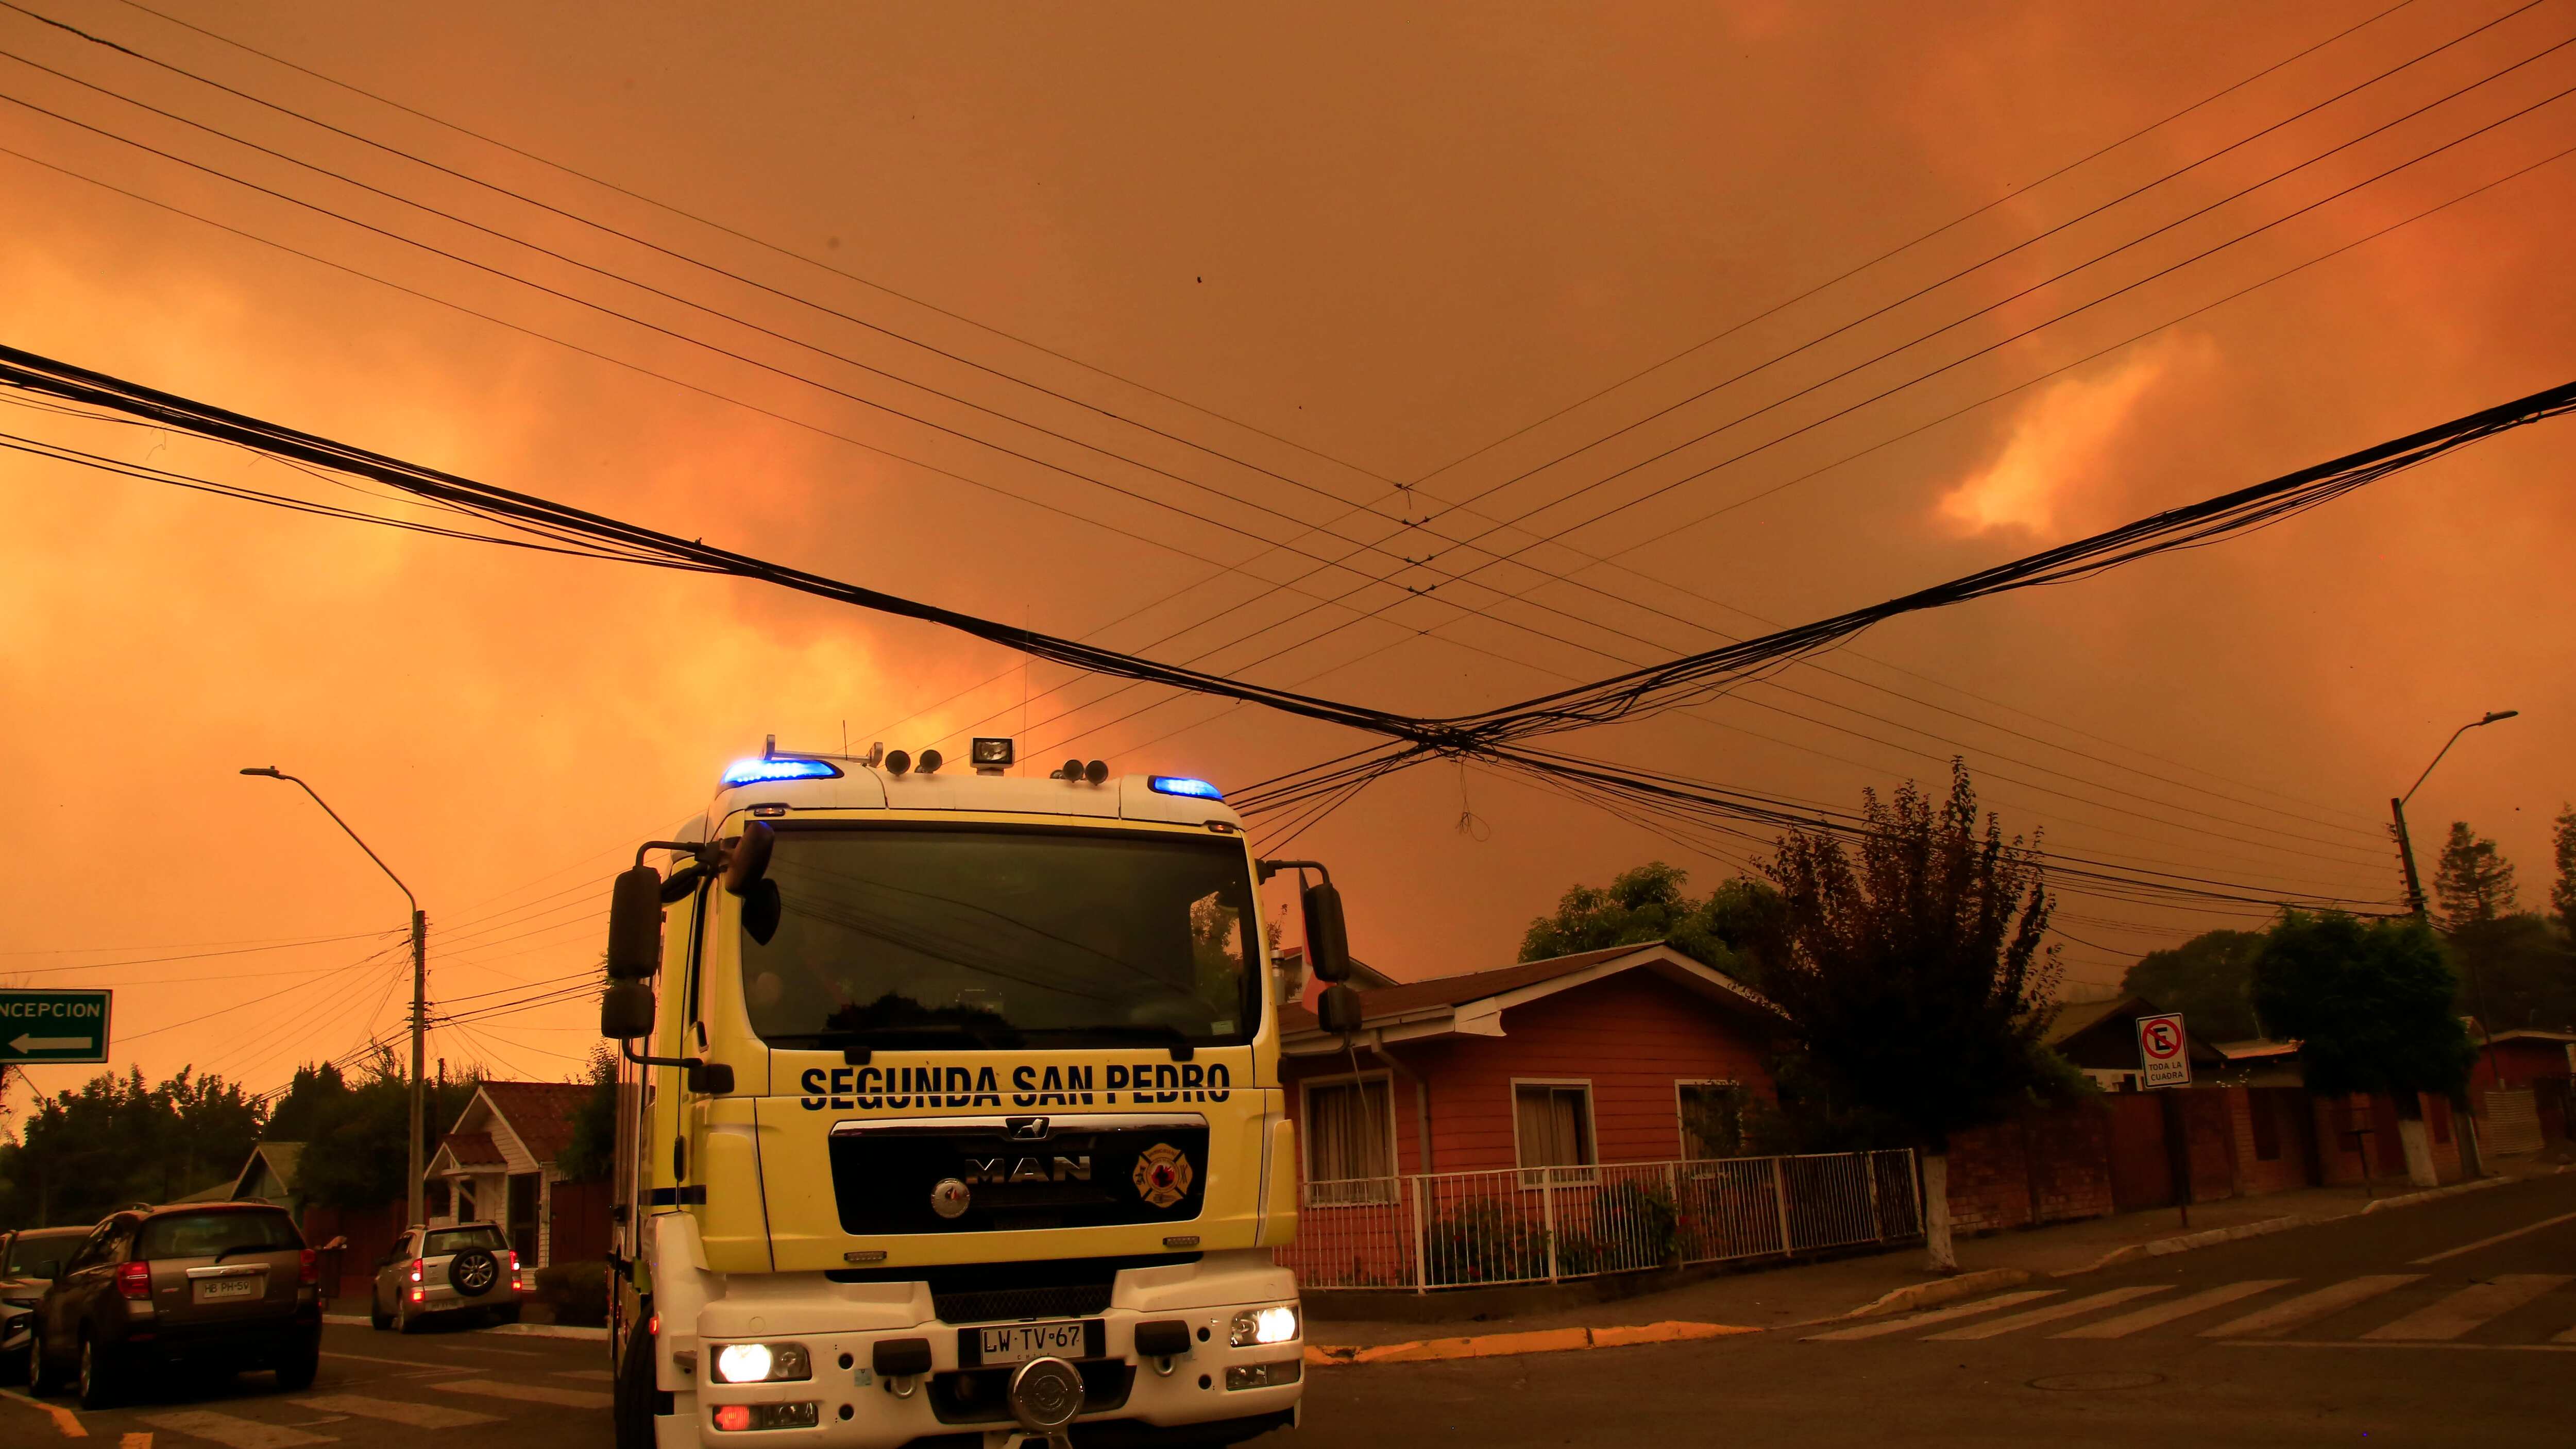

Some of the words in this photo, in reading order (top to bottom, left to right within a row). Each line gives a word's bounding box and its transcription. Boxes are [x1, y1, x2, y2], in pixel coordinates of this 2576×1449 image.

[0, 1003, 100, 1017] NCEPCION
[2151, 1071, 2183, 1081] CUADRA
[801, 1066, 1001, 1111] SEGUNDA
[1012, 1065, 1095, 1107] SAN
[1107, 1064, 1231, 1104] PEDRO
[965, 1156, 1091, 1184] MAN
